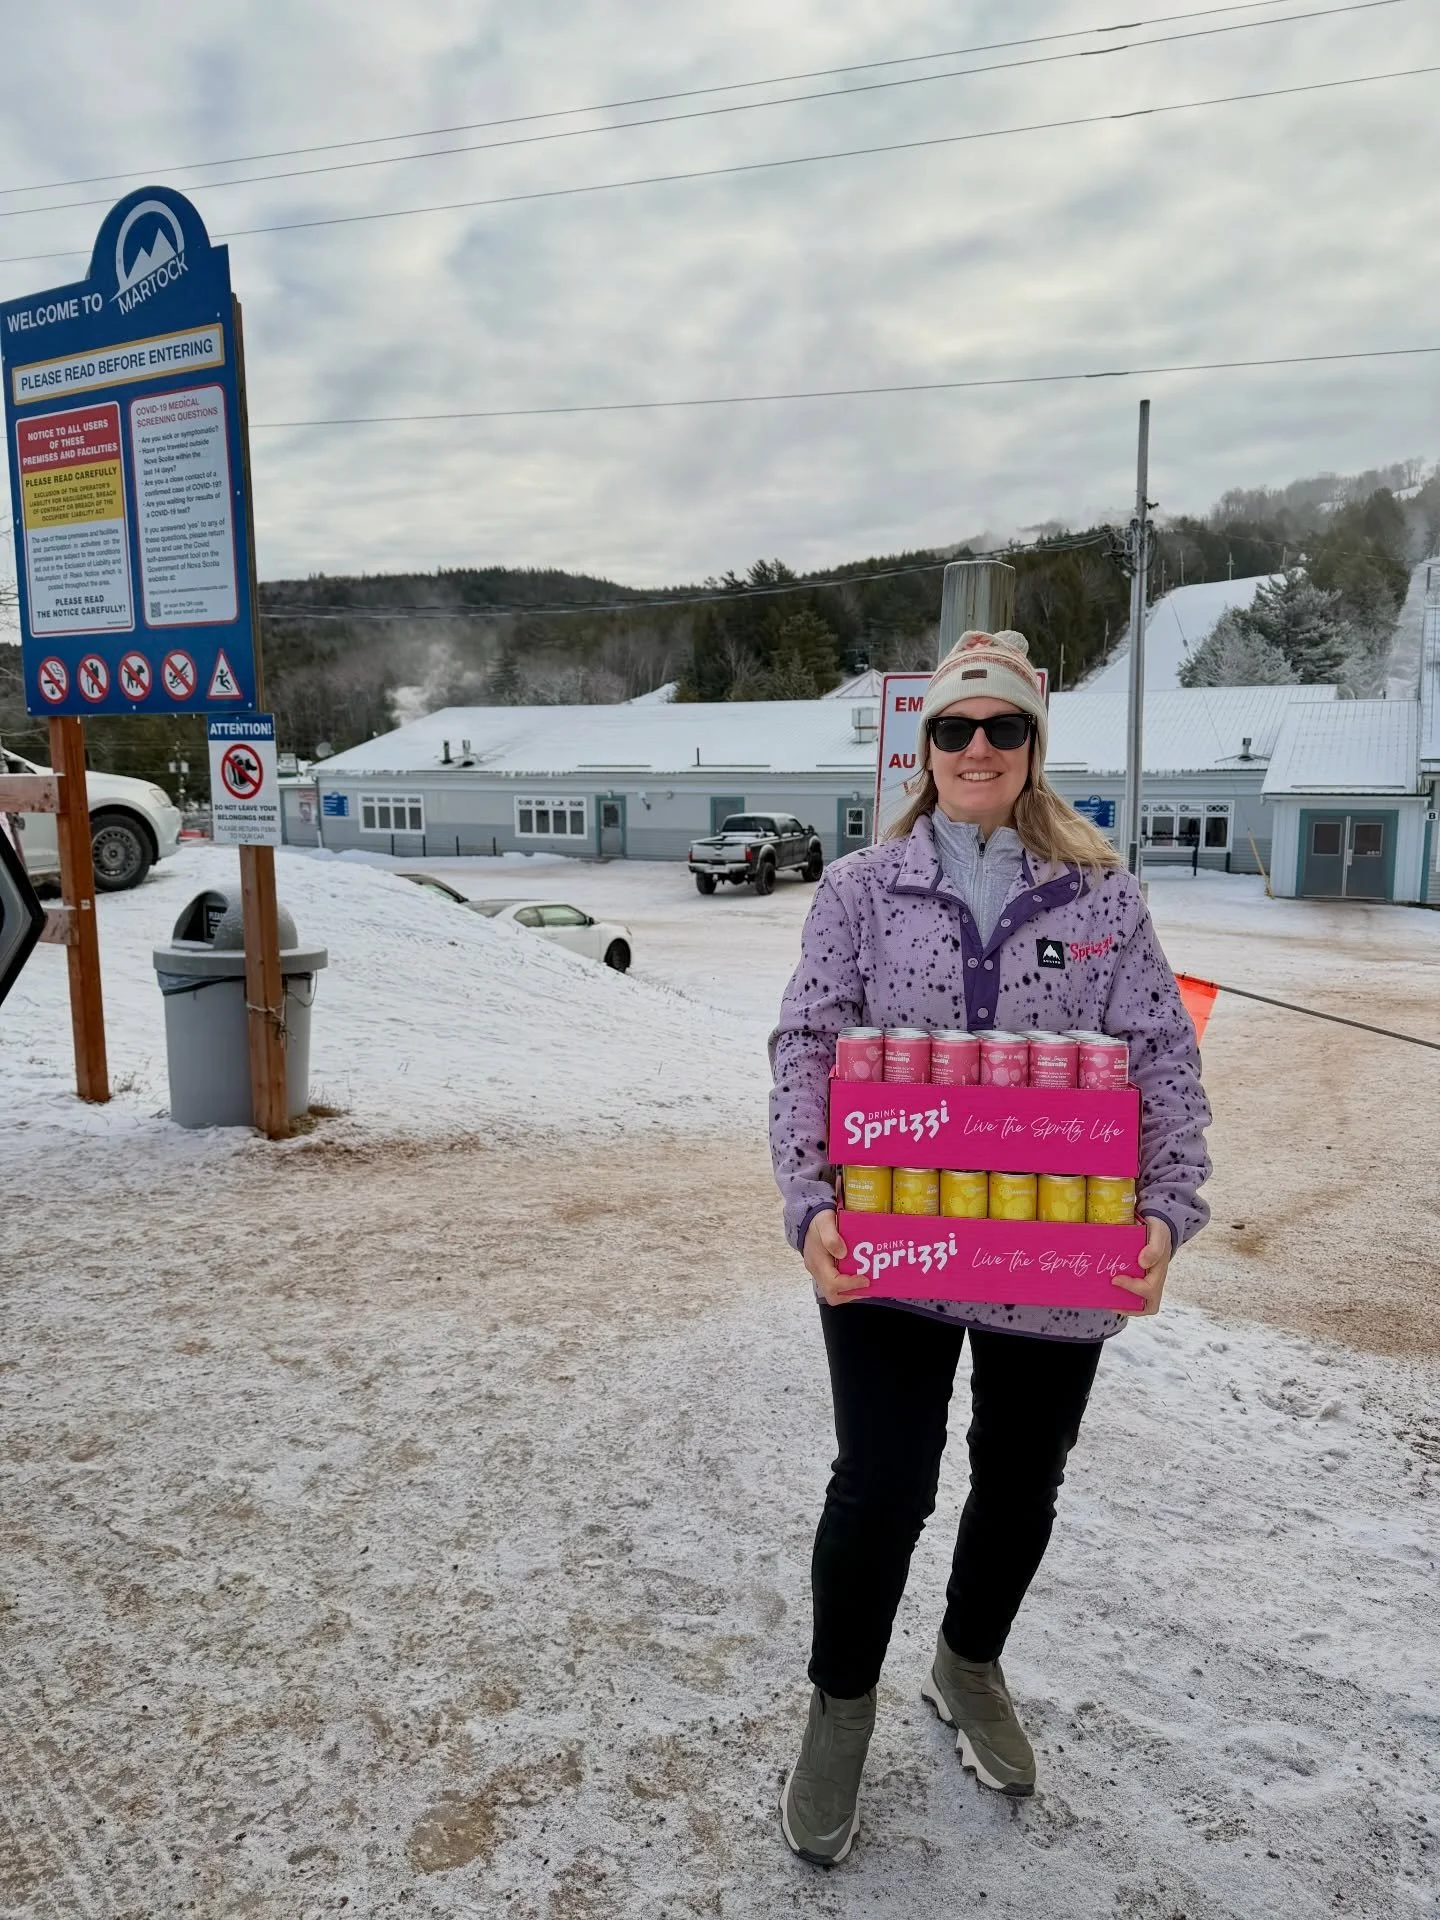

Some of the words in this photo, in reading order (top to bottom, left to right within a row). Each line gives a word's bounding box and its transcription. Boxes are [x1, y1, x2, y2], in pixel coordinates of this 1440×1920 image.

[118, 255, 188, 315] MARTOCK
[7, 299, 78, 332] WELCOME
[85, 293, 102, 312] TO
[21, 371, 62, 390] PLEASE
[66, 363, 95, 382] READ
[99, 353, 145, 375] BEFORE
[150, 339, 213, 364] ENTERING
[136, 404, 167, 416] COVID-19
[169, 398, 200, 410] MEDICAL
[137, 414, 176, 427] SCREENING
[177, 407, 218, 420] QUESTIONS
[28, 429, 54, 441] NOTICE
[68, 424, 81, 434] ALL
[83, 420, 108, 431] USERS
[181, 425, 219, 438] symptomatic?
[49, 441, 58, 449] OF
[61, 436, 85, 446] THESE
[167, 442, 188, 450] traveled
[23, 452, 58, 466] PREMISES
[61, 450, 75, 460] AND
[77, 443, 118, 456] FACILITIES
[26, 477, 52, 487] PLEASE
[54, 473, 72, 483] READ
[75, 466, 117, 480] CAREFULLY
[161, 465, 176, 473] days?
[145, 488, 171, 497] confirmed
[192, 480, 222, 490] COVID-19?
[151, 509, 176, 517] COVID-19
[55, 597, 82, 606] PLEASE
[85, 595, 104, 603] READ
[53, 608, 79, 617] NOTICE
[81, 604, 126, 615] CAREFULLY!
[210, 723, 272, 735] ATTENTION!
[868, 1108, 896, 1120] DRINK
[844, 1100, 949, 1148] Sprizzi
[964, 1114, 1001, 1136] Live
[1000, 1116, 1028, 1139] the
[1031, 1116, 1085, 1143] Spritz
[1090, 1119, 1124, 1142] Life
[877, 1240, 904, 1250] DRINK
[853, 1233, 958, 1279] Sprizzi
[972, 1248, 1009, 1268] Live
[1007, 1250, 1036, 1273] the
[1038, 1251, 1092, 1277] Spritz
[1097, 1253, 1130, 1277] Life
